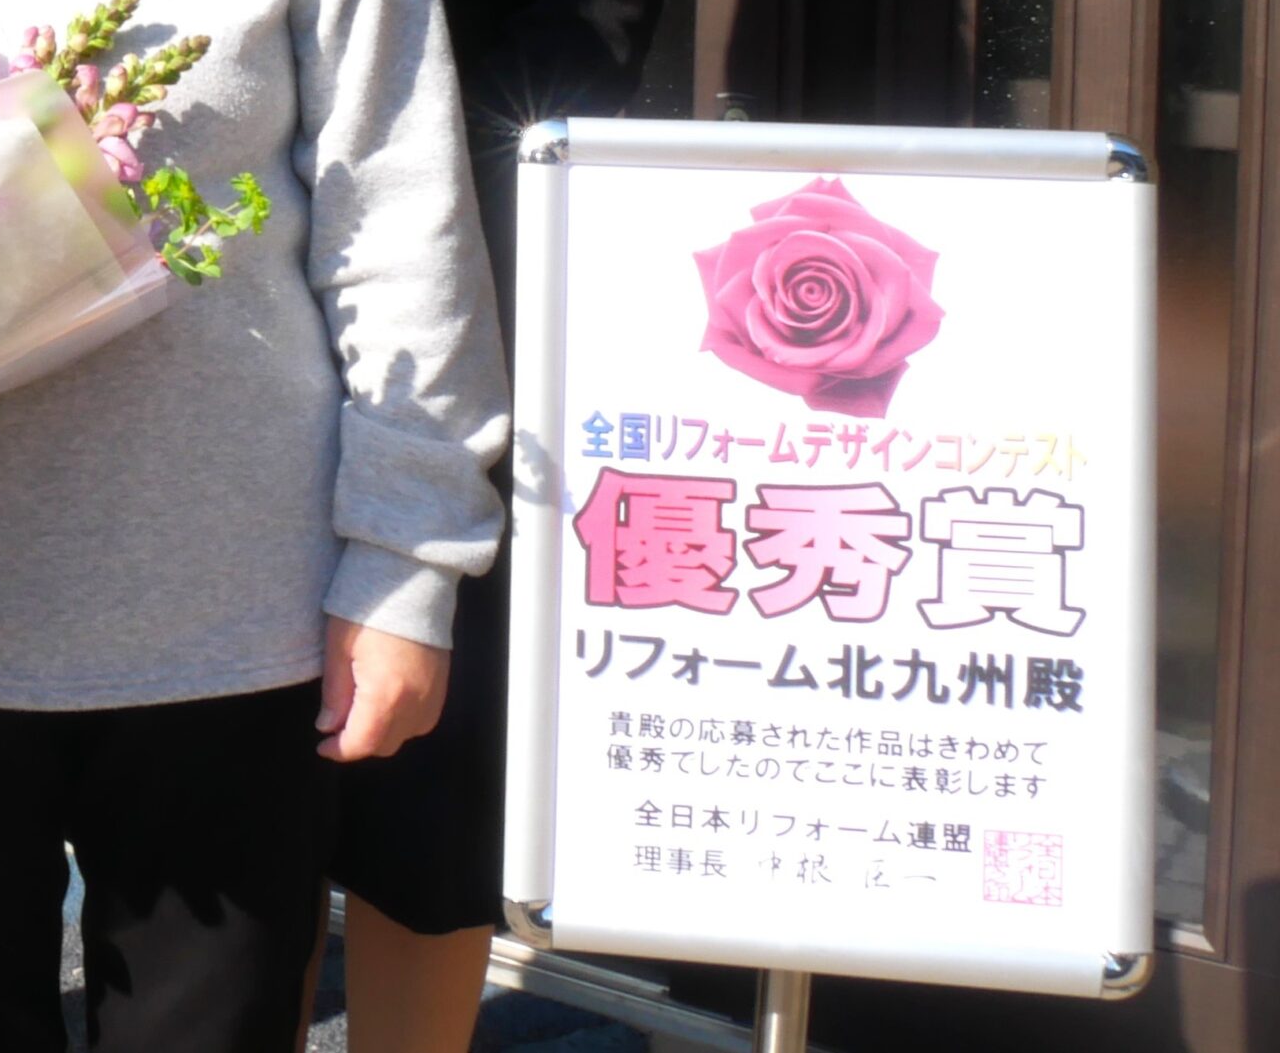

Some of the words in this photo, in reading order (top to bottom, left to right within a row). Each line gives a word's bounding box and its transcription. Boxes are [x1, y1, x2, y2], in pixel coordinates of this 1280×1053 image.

[581, 410, 1088, 481] 全国リフォームデザインコンテスト
[572, 466, 1087, 638] 優秀賞
[575, 628, 1085, 714] リフォーム北九州殿
[608, 711, 1049, 766] 貴殿の応募された作品はきわめて
[633, 799, 973, 854] 全日本リフォーム連盟
[633, 844, 729, 878] 理事長
